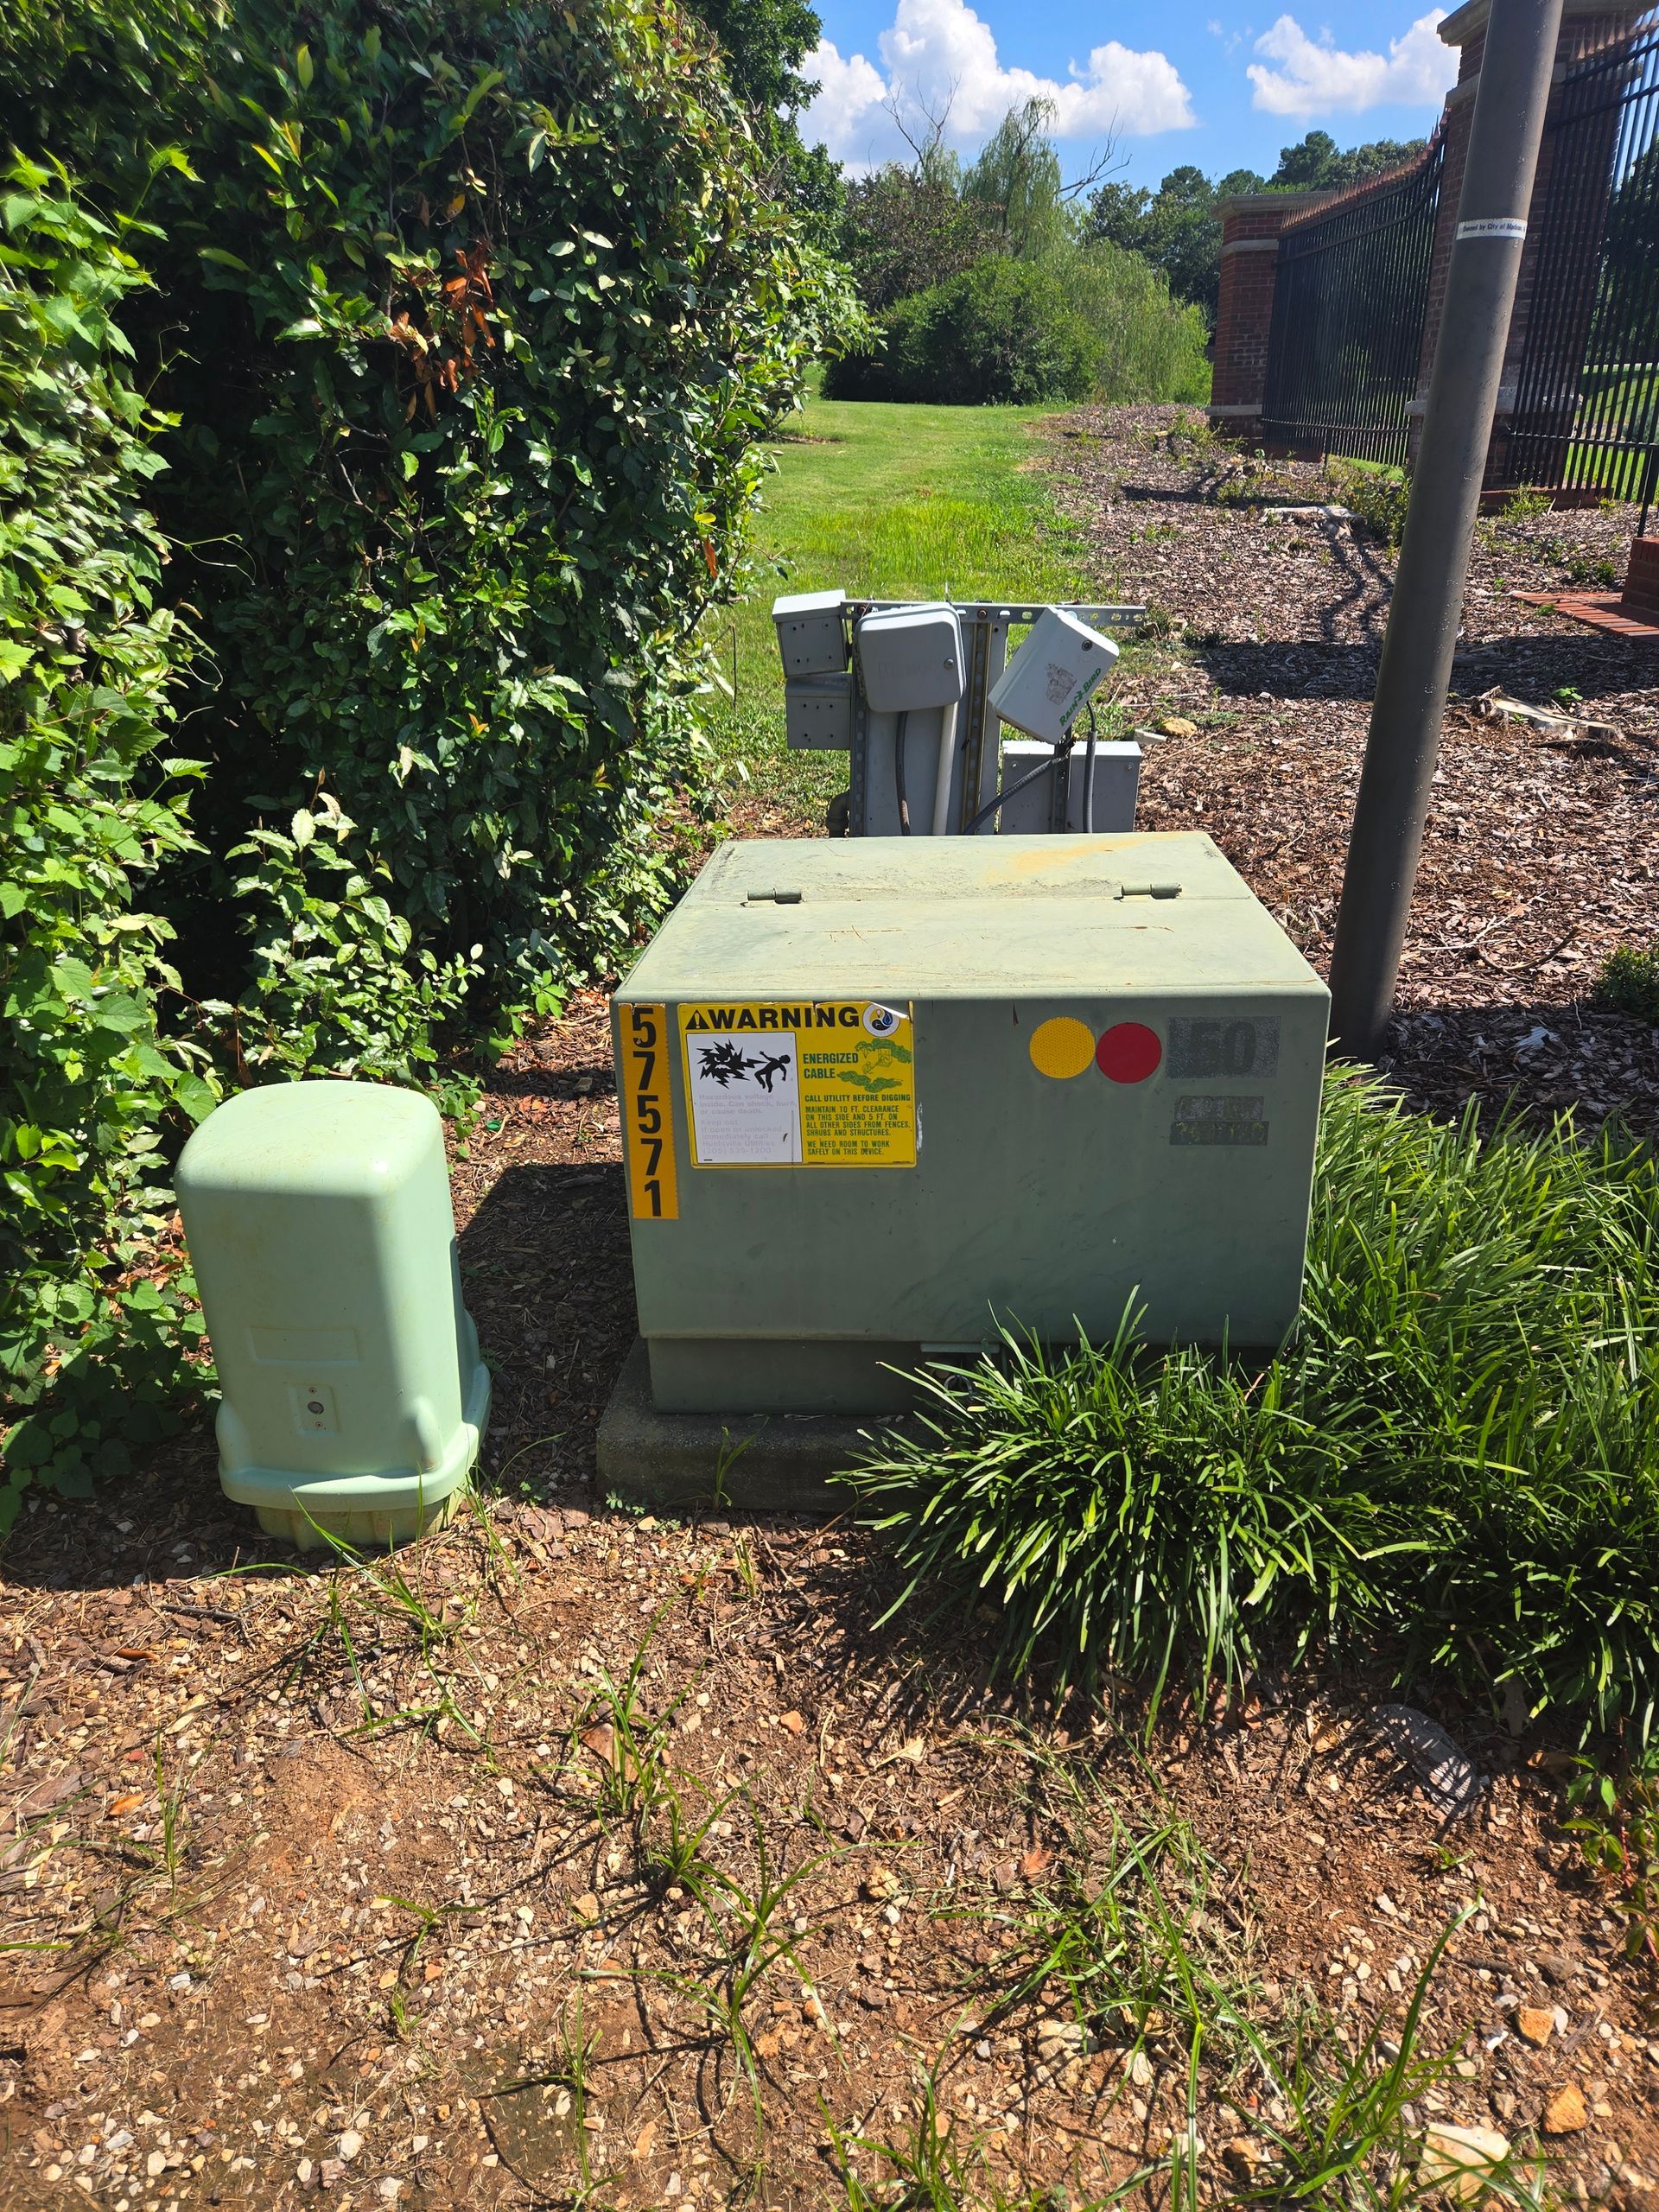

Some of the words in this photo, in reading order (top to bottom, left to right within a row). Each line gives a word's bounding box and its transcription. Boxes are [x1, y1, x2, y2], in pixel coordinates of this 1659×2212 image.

[708, 1007, 860, 1029] WARNING
[804, 1052, 858, 1064] ENERGIZED
[804, 1068, 836, 1078] CABLE
